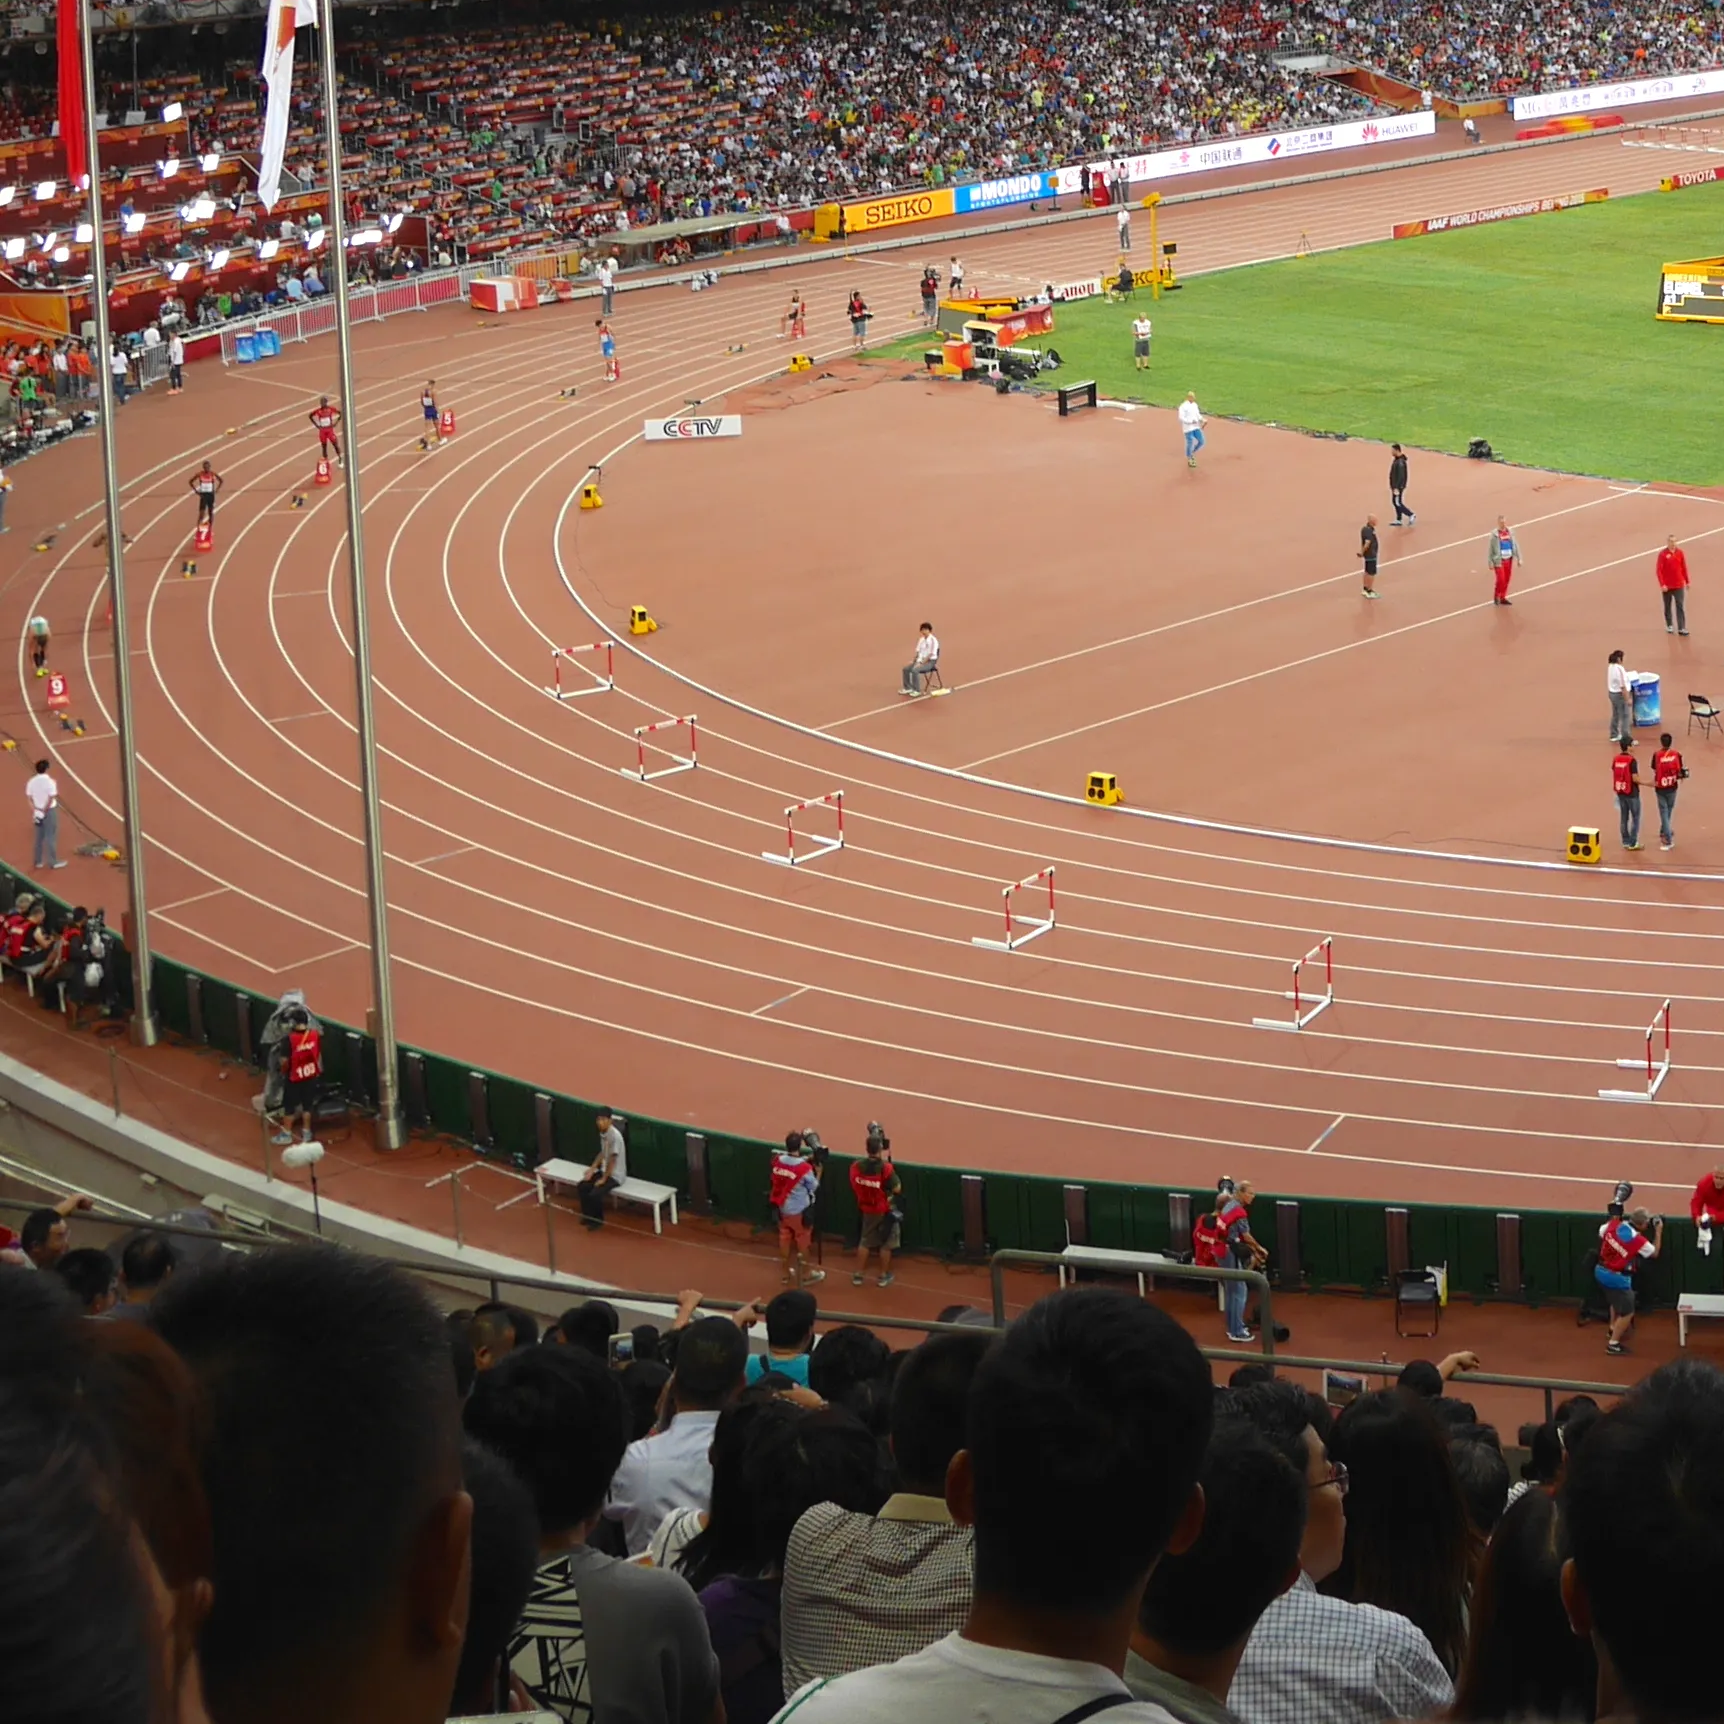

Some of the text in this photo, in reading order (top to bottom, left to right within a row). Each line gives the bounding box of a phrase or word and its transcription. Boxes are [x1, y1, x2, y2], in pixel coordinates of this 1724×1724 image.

[1382, 122, 1418, 136] HUAWEI
[1200, 146, 1243, 166] 中国联通
[1677, 167, 1717, 187] TOYOTA
[981, 174, 1042, 201] MONDO
[866, 196, 932, 225] SEIKO
[1427, 219, 1449, 231] IAAF
[1450, 211, 1478, 227] WORLD
[444, 414, 452, 425] 5
[663, 417, 722, 437] CCTV
[199, 528, 208, 541] 7
[52, 678, 63, 694] 9
[772, 1166, 797, 1180] Canon
[1605, 1232, 1628, 1258] Canon
